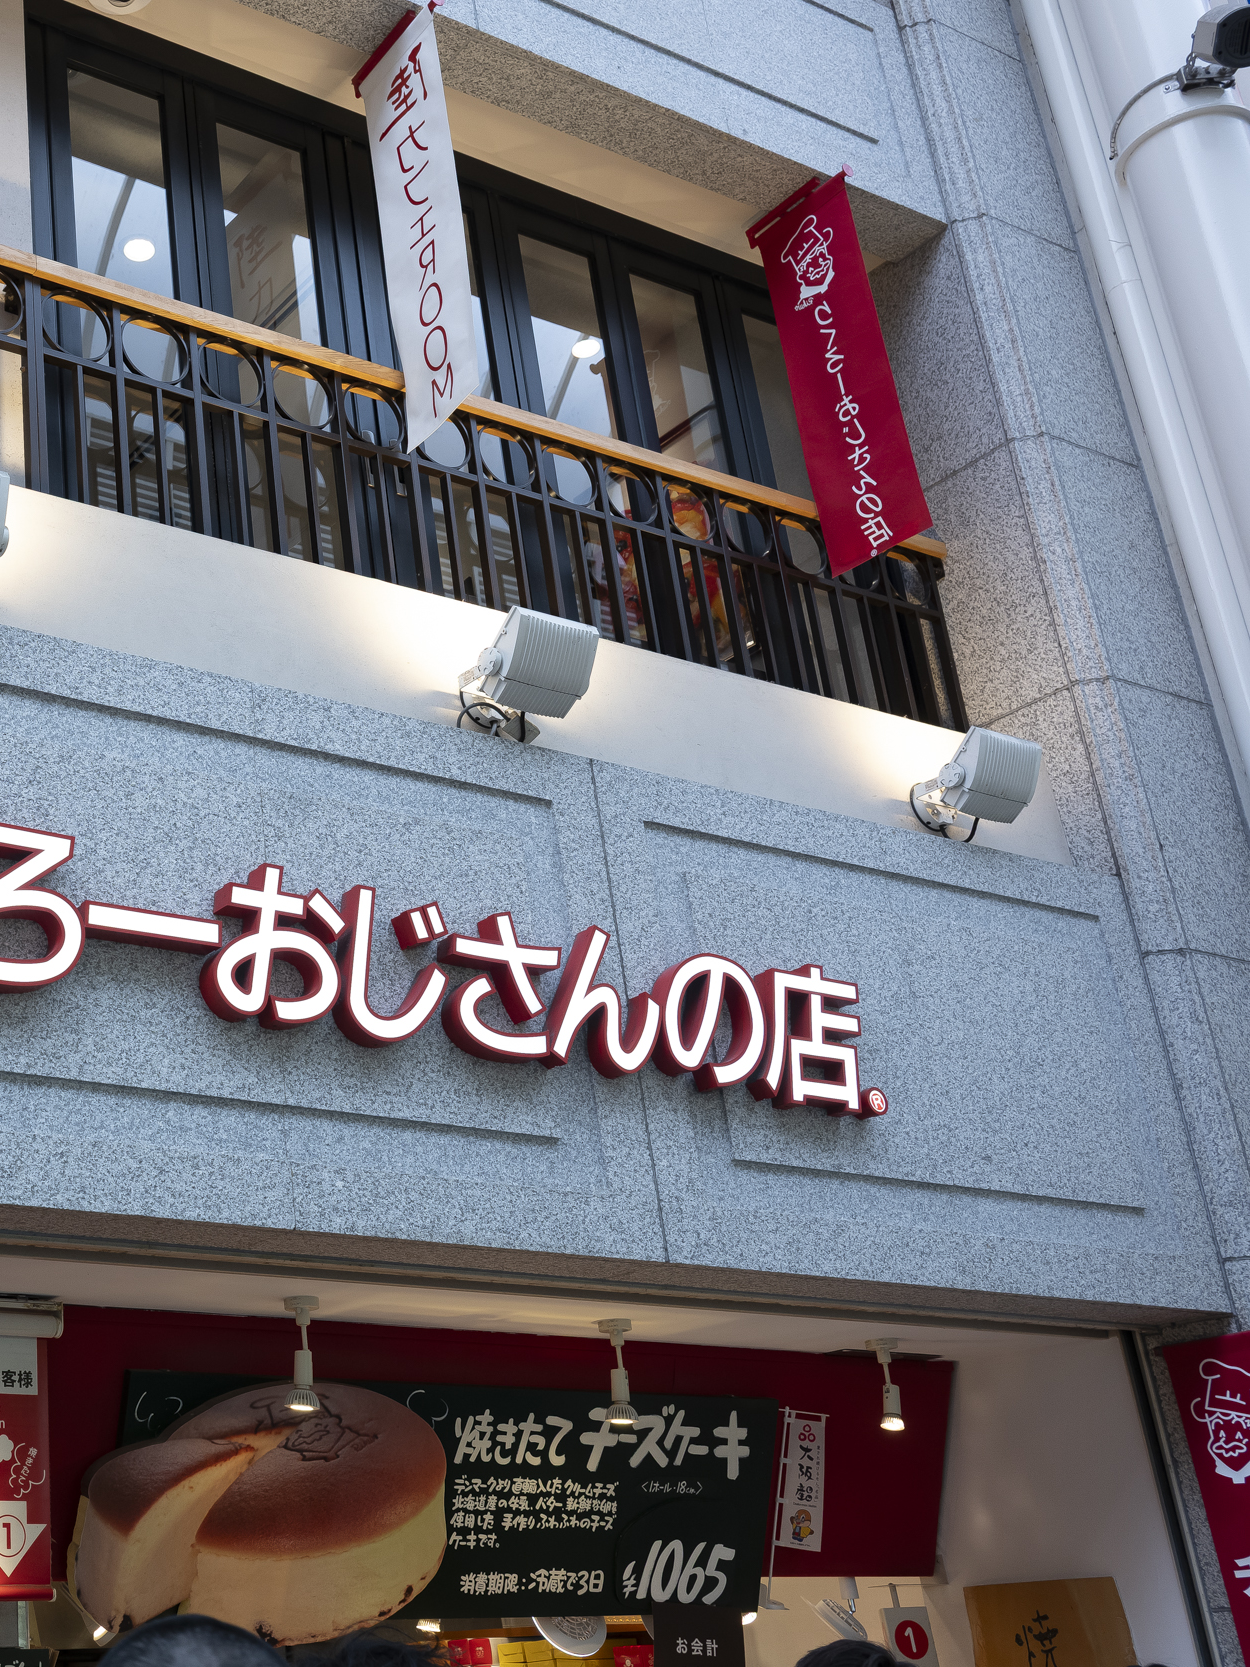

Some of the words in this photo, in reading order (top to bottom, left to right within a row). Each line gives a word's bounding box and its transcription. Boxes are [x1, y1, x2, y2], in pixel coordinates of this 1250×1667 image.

[676, 1637, 719, 1657] お会計
[904, 1626, 917, 1653] 1
